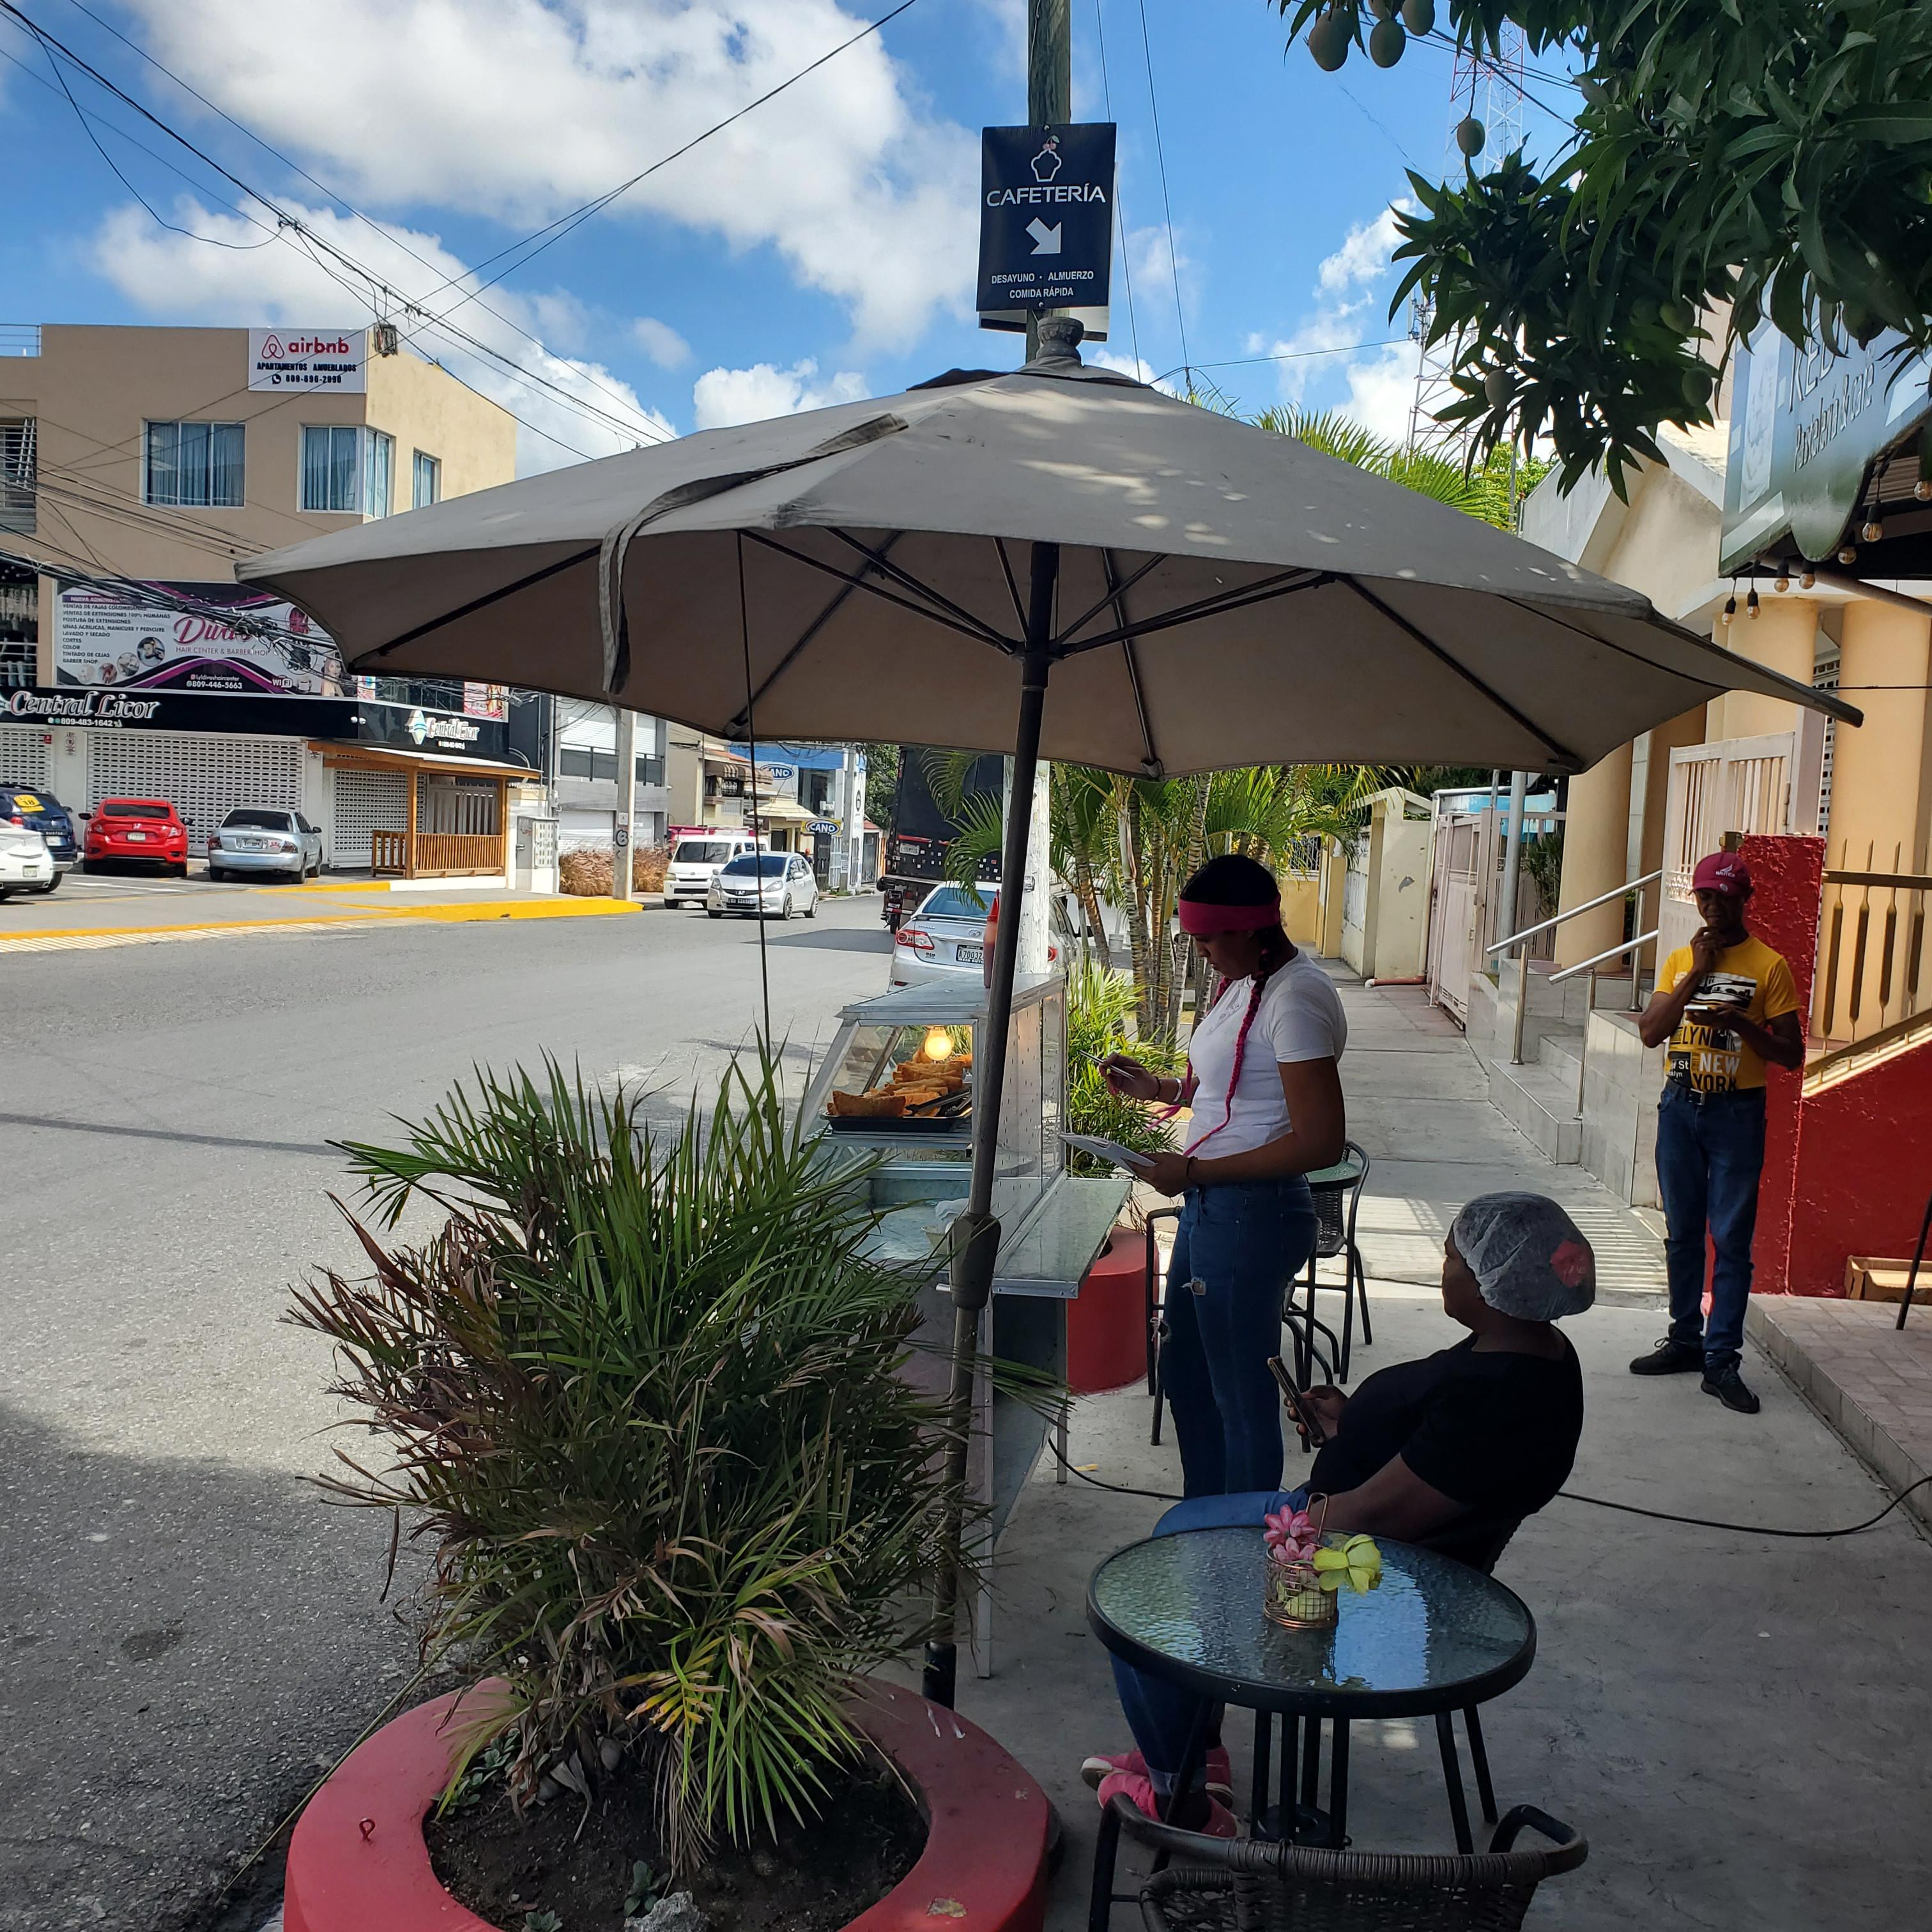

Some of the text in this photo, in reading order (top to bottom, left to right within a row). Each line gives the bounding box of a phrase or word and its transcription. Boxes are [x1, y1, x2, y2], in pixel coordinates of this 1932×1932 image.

[986, 183, 1106, 206] CAFETERÍA
[992, 271, 1094, 284] DESAYUNO ALMUERZO
[1009, 286, 1074, 298] COMIDA RÁPIDA
[288, 337, 349, 353] airbnb
[257, 362, 356, 372] APARTAMENTOS AMUEBLADOS
[10, 691, 161, 719] Central Licor
[61, 718, 113, 726] 809-483-1642
[425, 717, 460, 738] Central
[958, 950, 985, 960] A70032
[1699, 1052, 1740, 1075] NEW
